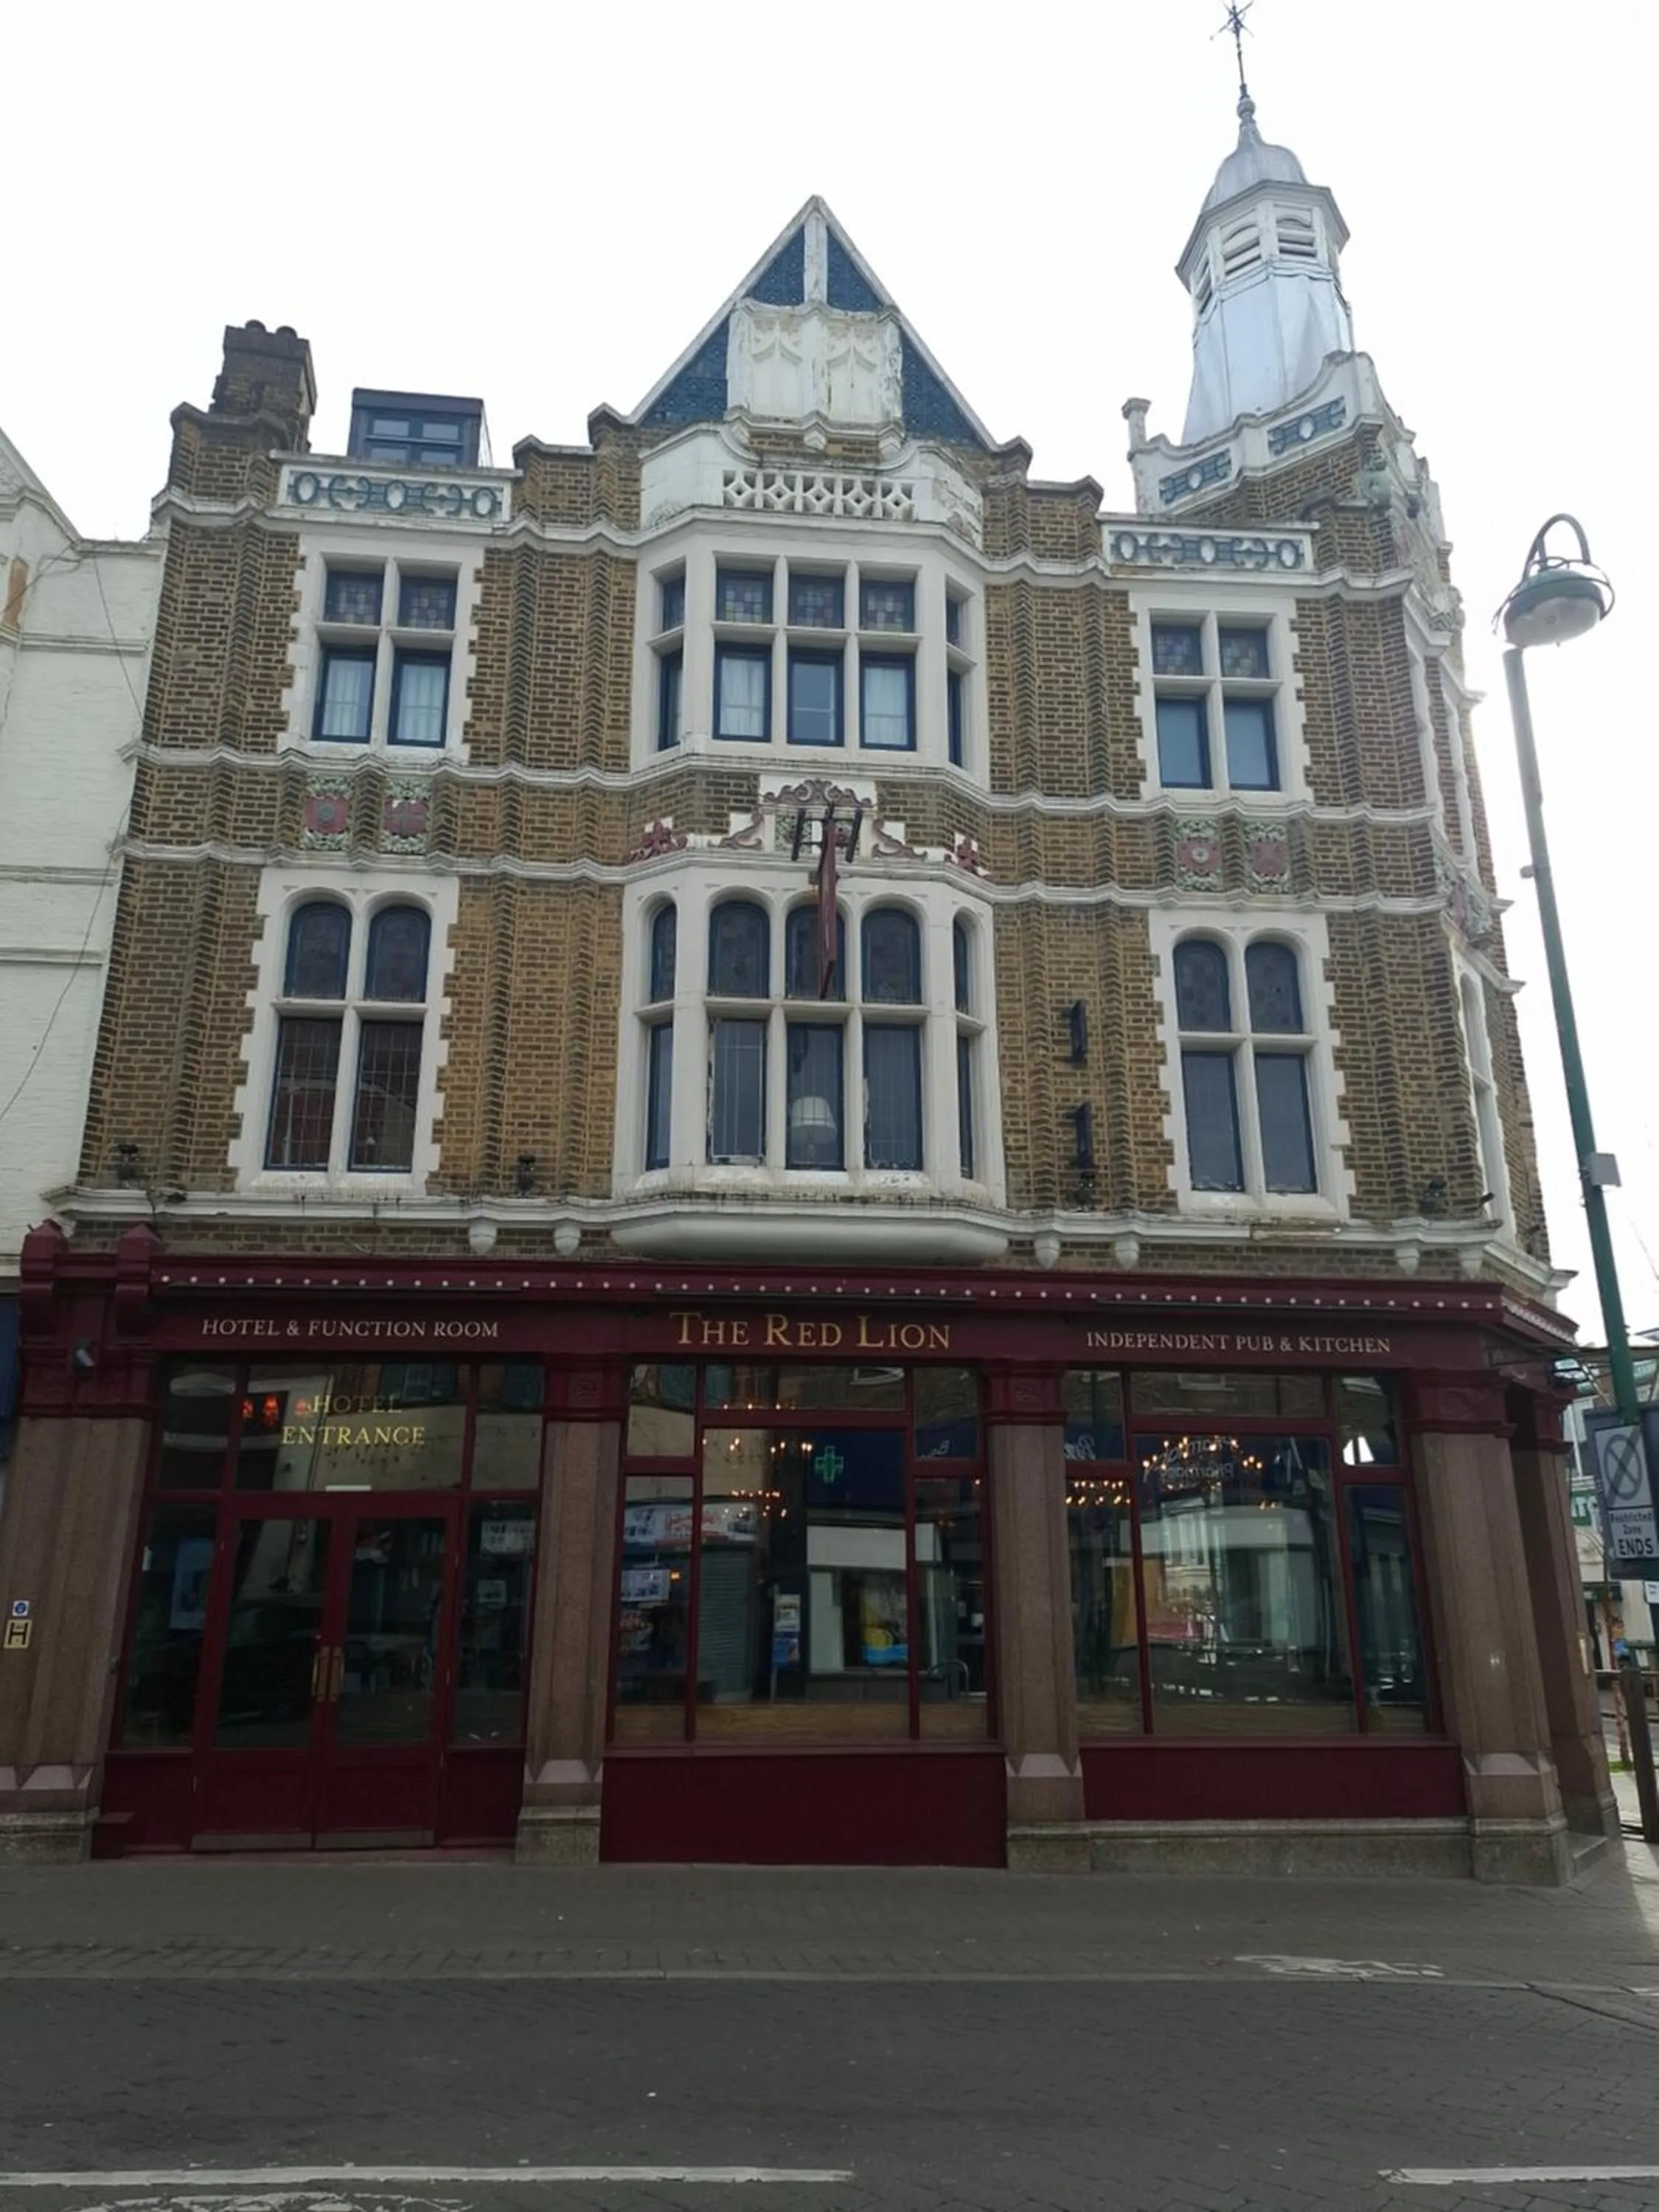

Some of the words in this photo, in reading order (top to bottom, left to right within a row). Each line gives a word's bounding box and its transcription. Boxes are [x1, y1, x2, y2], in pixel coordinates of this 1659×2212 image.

[201, 1318, 281, 1336] HOTEL
[286, 1319, 299, 1337] &
[307, 1320, 428, 1338] FUNCTION
[433, 1321, 500, 1338] ROOM
[669, 1312, 750, 1346] THE
[763, 1312, 843, 1348] RED
[855, 1314, 951, 1350] LION
[1086, 1332, 1231, 1350] INDEPENDENT
[1236, 1335, 1275, 1352] PUB
[1279, 1335, 1293, 1352] &
[1298, 1335, 1391, 1354] KITCHEN
[313, 1394, 403, 1413] HOTEL
[282, 1425, 426, 1445] ENTRANCE
[1618, 1537, 1655, 1556] ENDS
[7, 1621, 29, 1646] H
